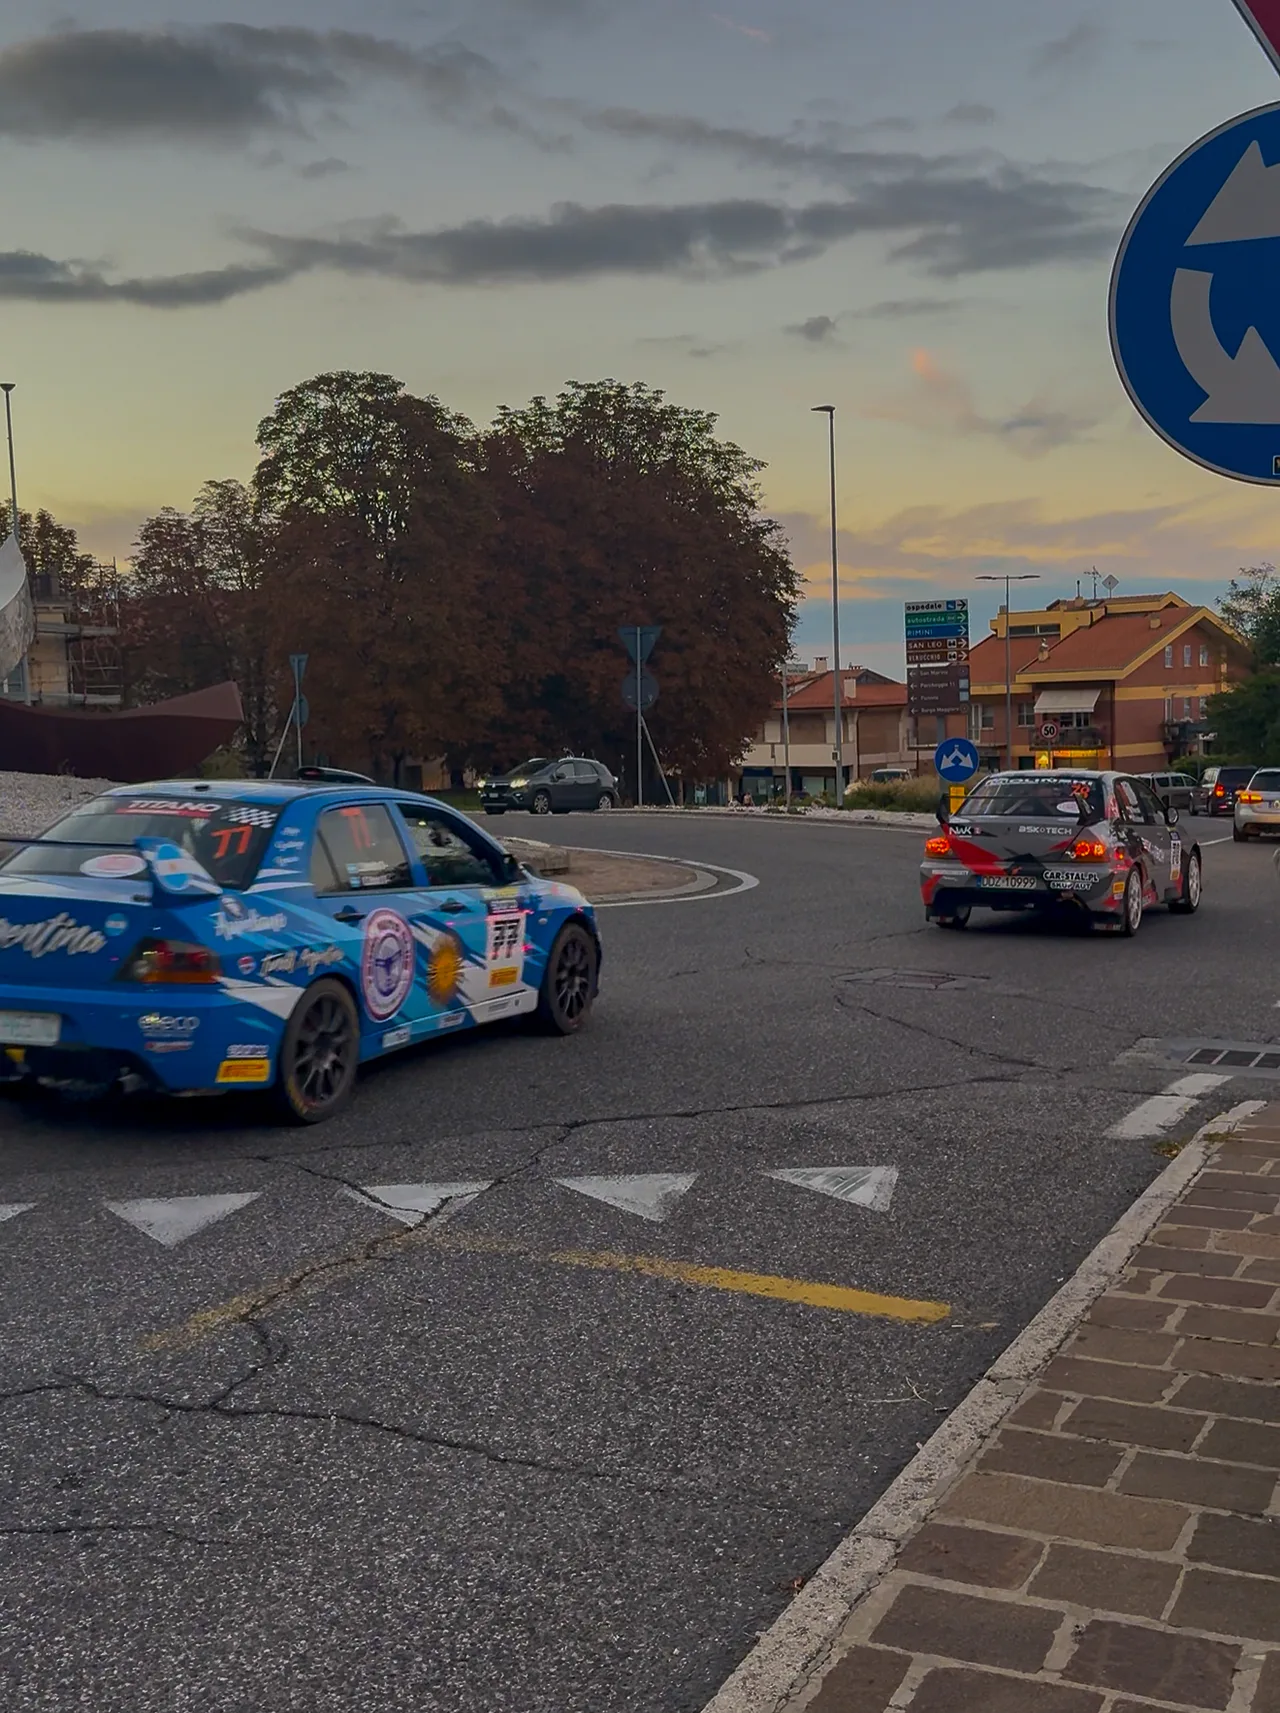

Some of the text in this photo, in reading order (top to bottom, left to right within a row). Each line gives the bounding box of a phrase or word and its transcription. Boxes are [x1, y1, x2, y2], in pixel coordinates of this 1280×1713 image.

[906, 602, 942, 611] ospedale
[907, 615, 945, 624] autostrada
[1044, 725, 1055, 736] 50
[128, 800, 222, 812] TITANO
[949, 826, 972, 835] NWK
[210, 825, 253, 860] 77
[982, 876, 1036, 888] DDZ 10999
[1043, 870, 1100, 883] CAR-STAL.PL
